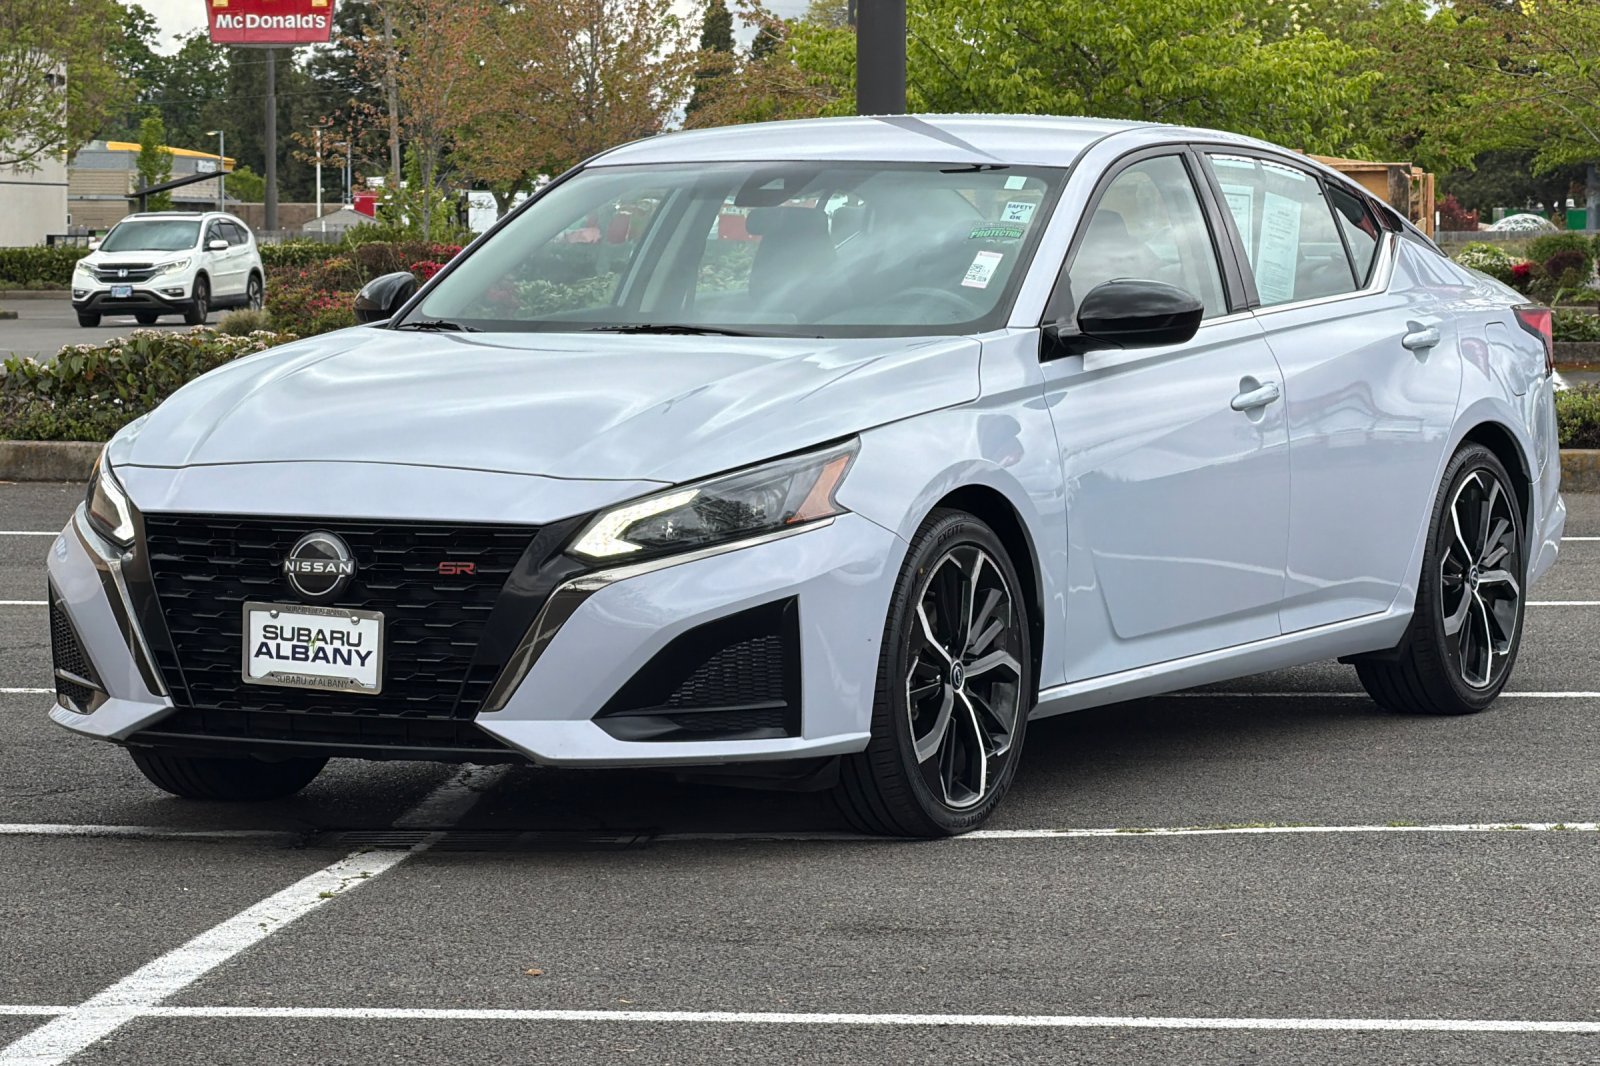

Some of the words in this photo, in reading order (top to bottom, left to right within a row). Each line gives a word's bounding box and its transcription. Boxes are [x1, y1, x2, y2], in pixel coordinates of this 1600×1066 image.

[216, 14, 326, 29] McDonald's
[285, 561, 352, 573] NISSAN
[438, 561, 476, 575] SR
[262, 624, 363, 647] SUBARU
[254, 641, 374, 667] ALBANY
[275, 675, 307, 685] SUBARU
[308, 678, 317, 686] of
[319, 678, 349, 688] ALBANY
